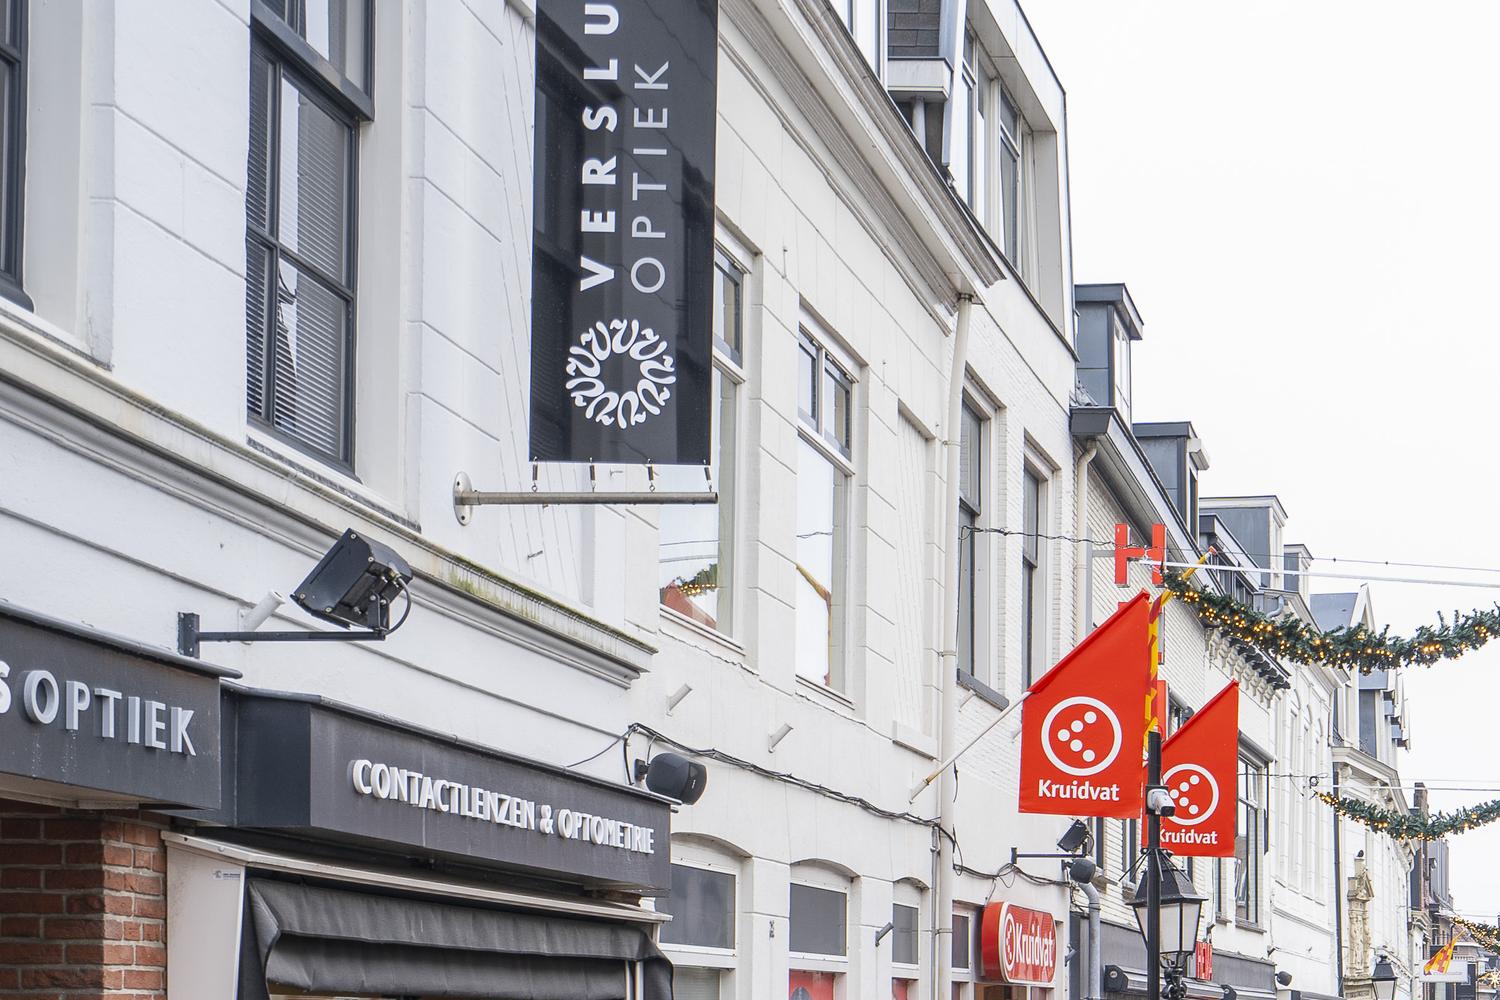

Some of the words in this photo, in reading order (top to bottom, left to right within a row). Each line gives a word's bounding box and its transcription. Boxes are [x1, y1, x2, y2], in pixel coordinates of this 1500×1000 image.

[580, 2, 619, 292] VERSLU
[630, 60, 670, 294] OPTIEK
[23, 669, 197, 757] OPTIEK
[351, 759, 535, 831] CONTACTLENZEN
[538, 804, 554, 835] &
[556, 808, 655, 854] OPTOMETRIE
[1038, 779, 1120, 801] Kruidvat
[1015, 922, 1054, 968] Kruidvat
